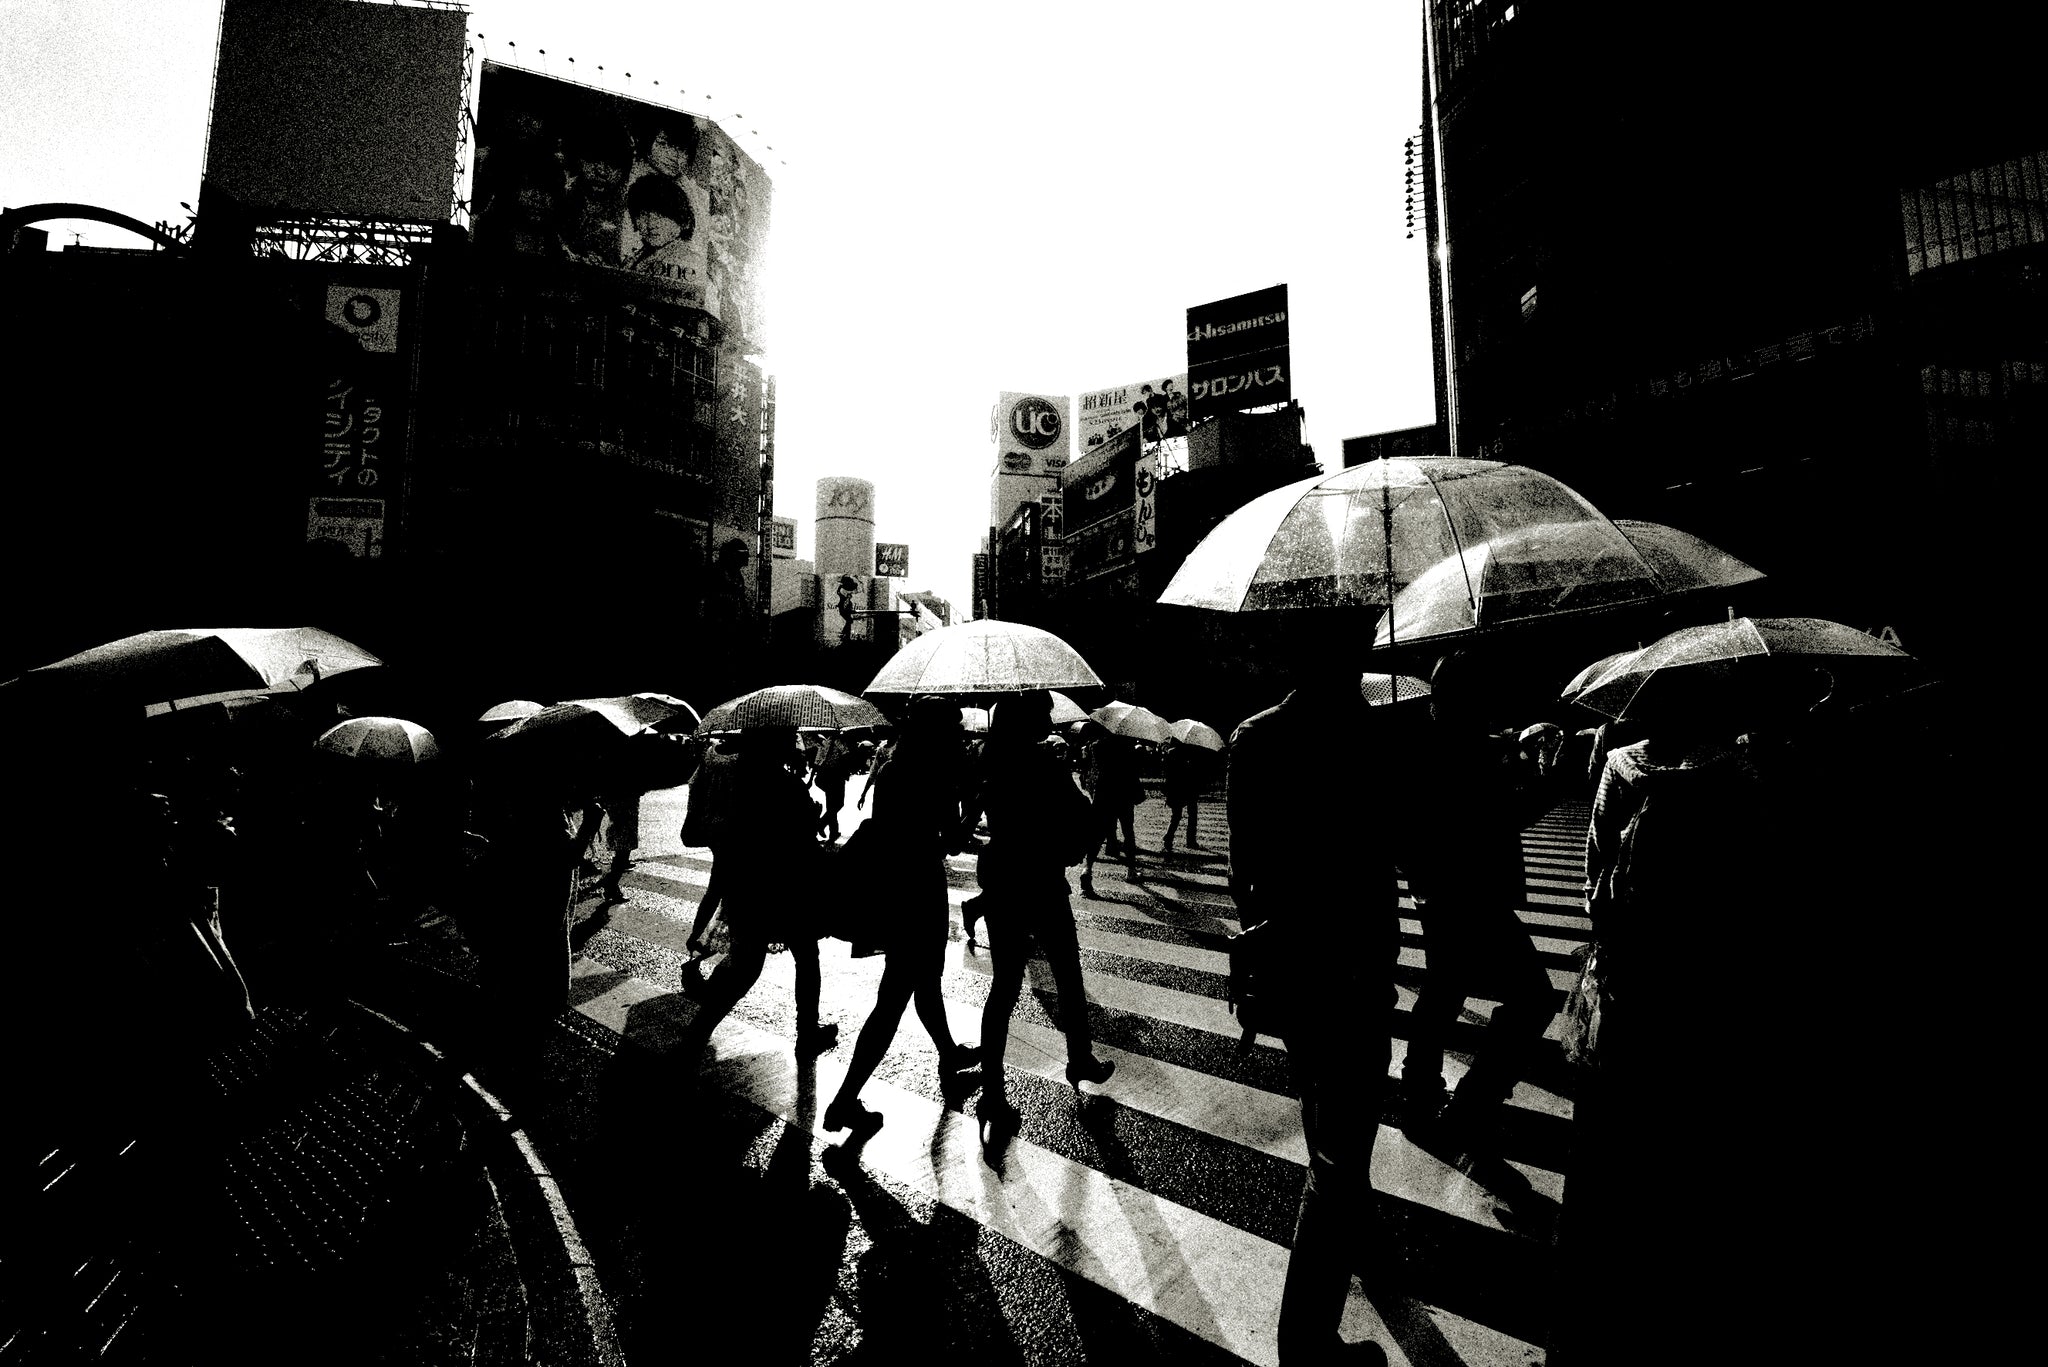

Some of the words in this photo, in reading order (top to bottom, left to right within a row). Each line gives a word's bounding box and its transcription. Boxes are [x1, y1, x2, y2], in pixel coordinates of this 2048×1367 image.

[1188, 311, 1286, 341] Hisamitsu
[1191, 364, 1285, 400] サロンパス
[324, 379, 353, 485] イシティ
[1045, 459, 1067, 468] VISA
